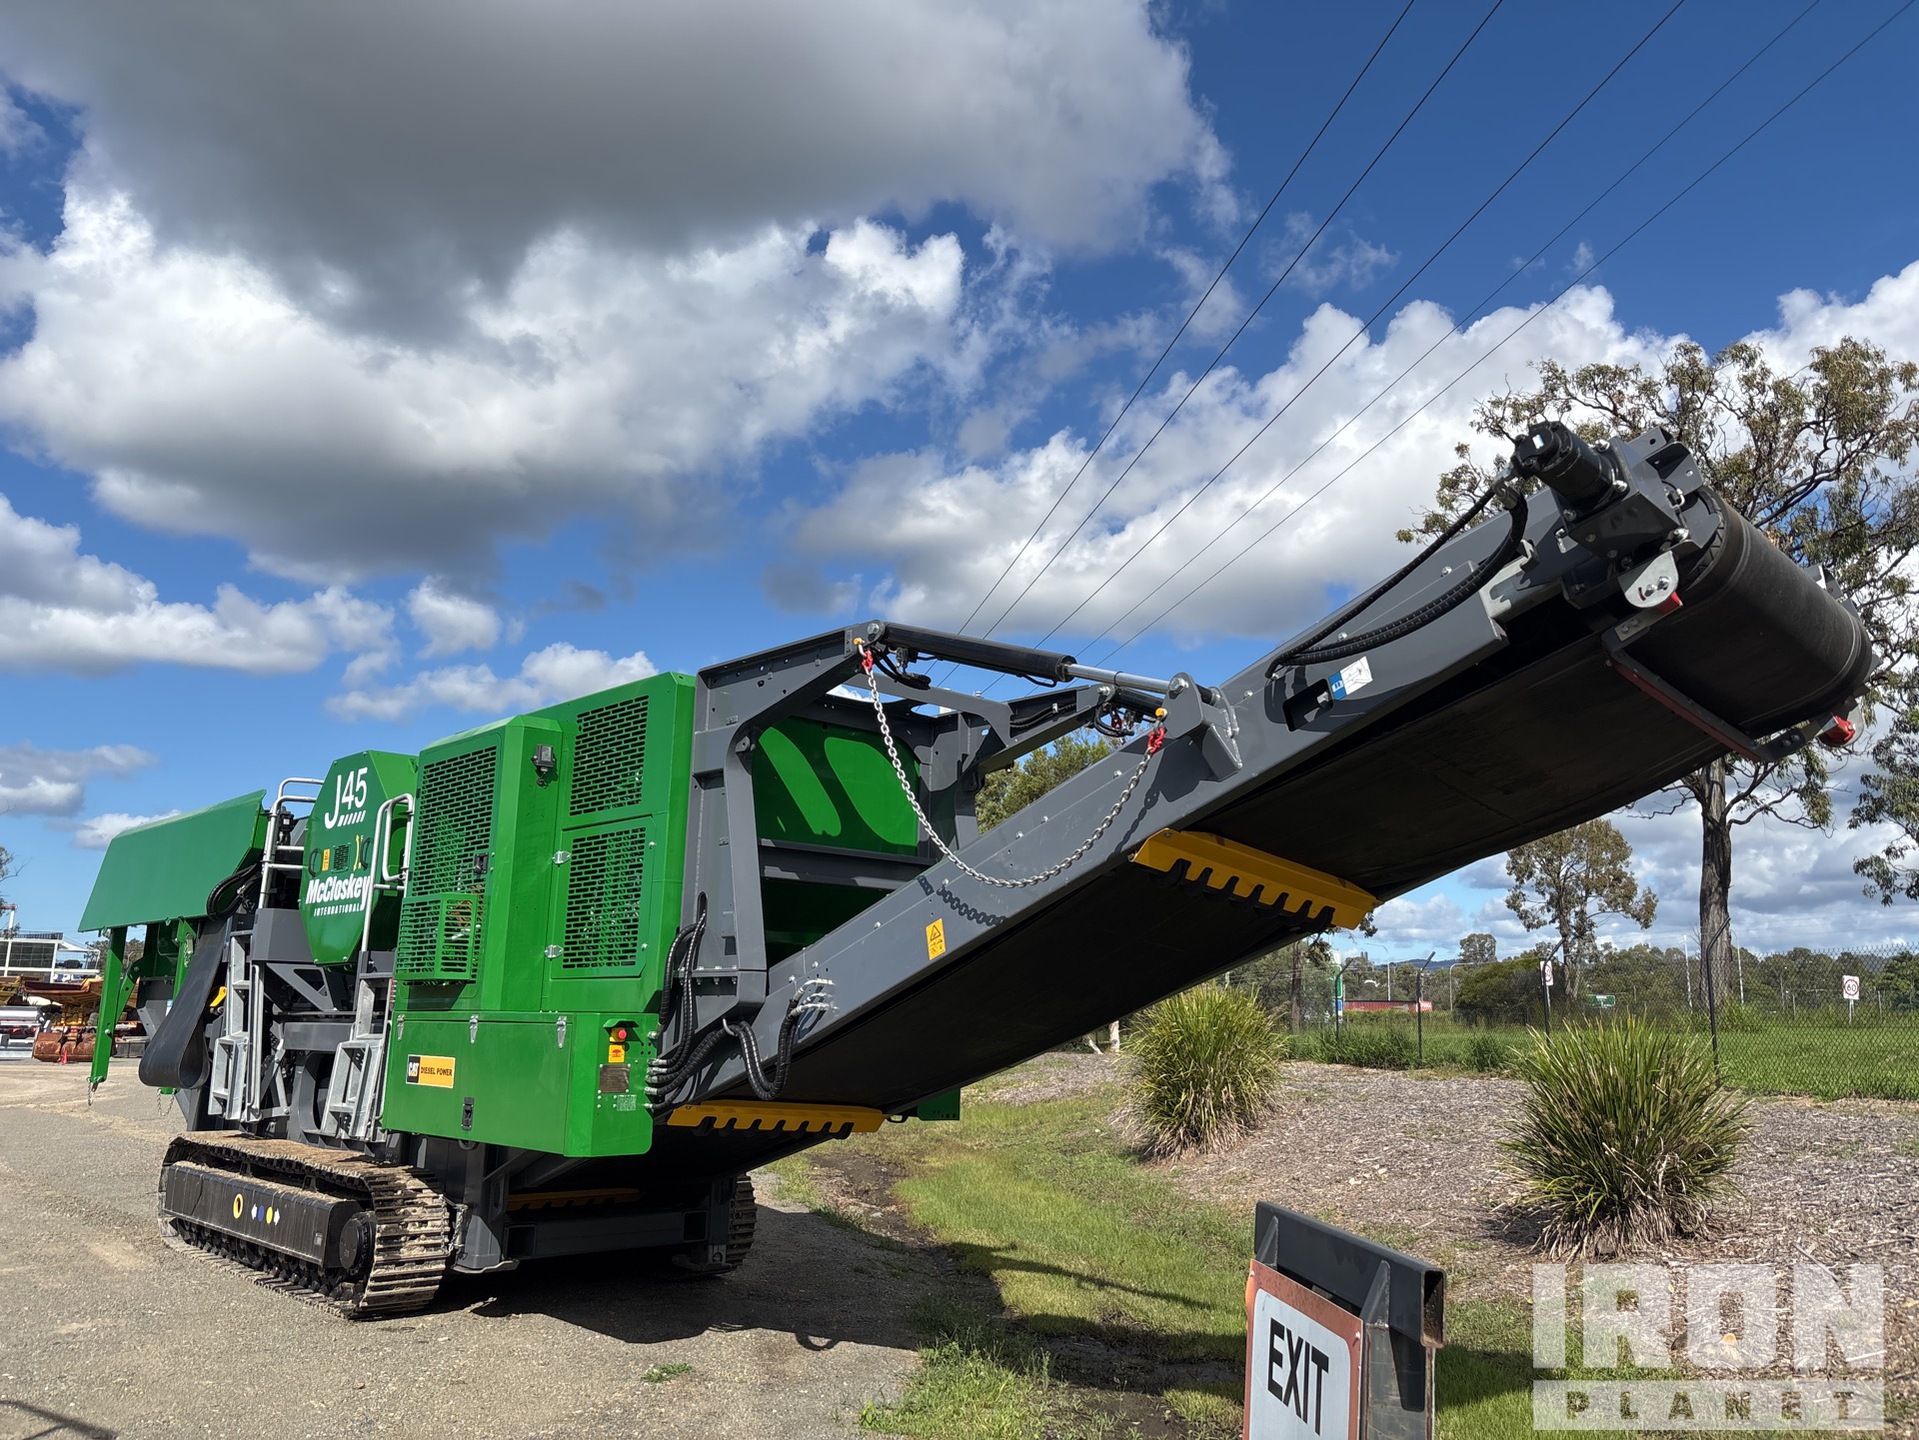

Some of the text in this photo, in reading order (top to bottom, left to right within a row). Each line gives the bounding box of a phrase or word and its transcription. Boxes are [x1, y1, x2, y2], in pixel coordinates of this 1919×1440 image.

[324, 767, 368, 829] J45
[305, 873, 371, 911] McCloskey
[313, 903, 361, 917] INTERNATIONAL
[408, 1061, 420, 1077] CAT
[420, 1066, 453, 1077] DIESEL POWER
[1268, 1317, 1329, 1437] EXIT
